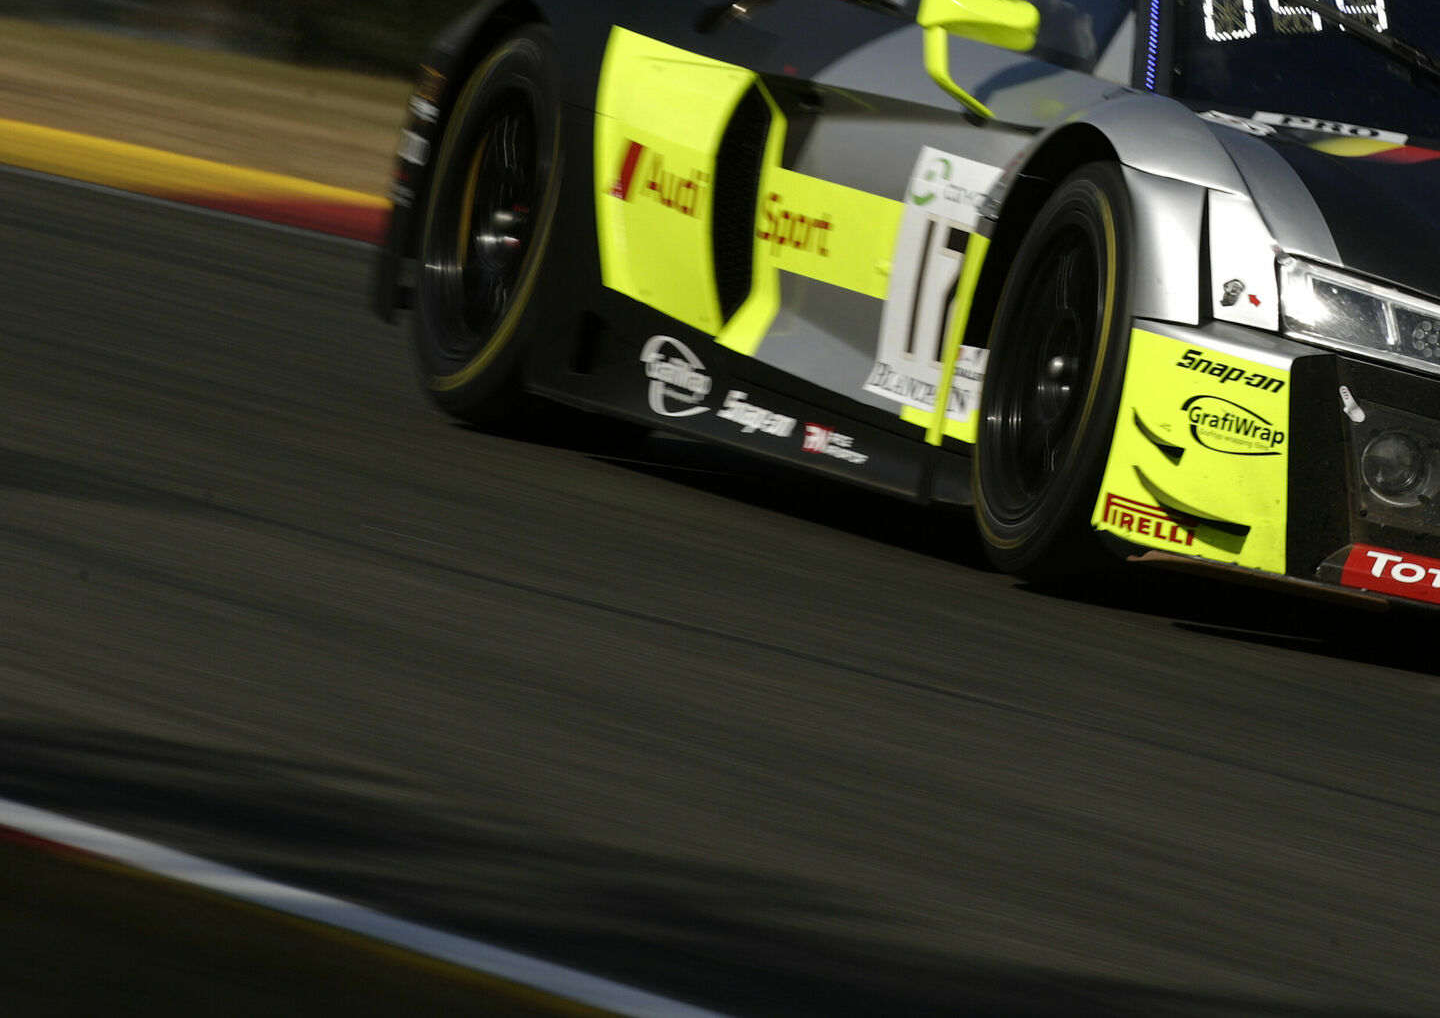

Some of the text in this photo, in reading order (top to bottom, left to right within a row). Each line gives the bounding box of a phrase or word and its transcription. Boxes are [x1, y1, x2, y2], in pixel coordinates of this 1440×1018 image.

[1281, 116, 1381, 138] PRO
[640, 152, 834, 258] Audi Sport
[1175, 349, 1286, 394] Snap-on
[1188, 405, 1286, 448] GrafiWrap
[1103, 492, 1199, 547] PIRELLI
